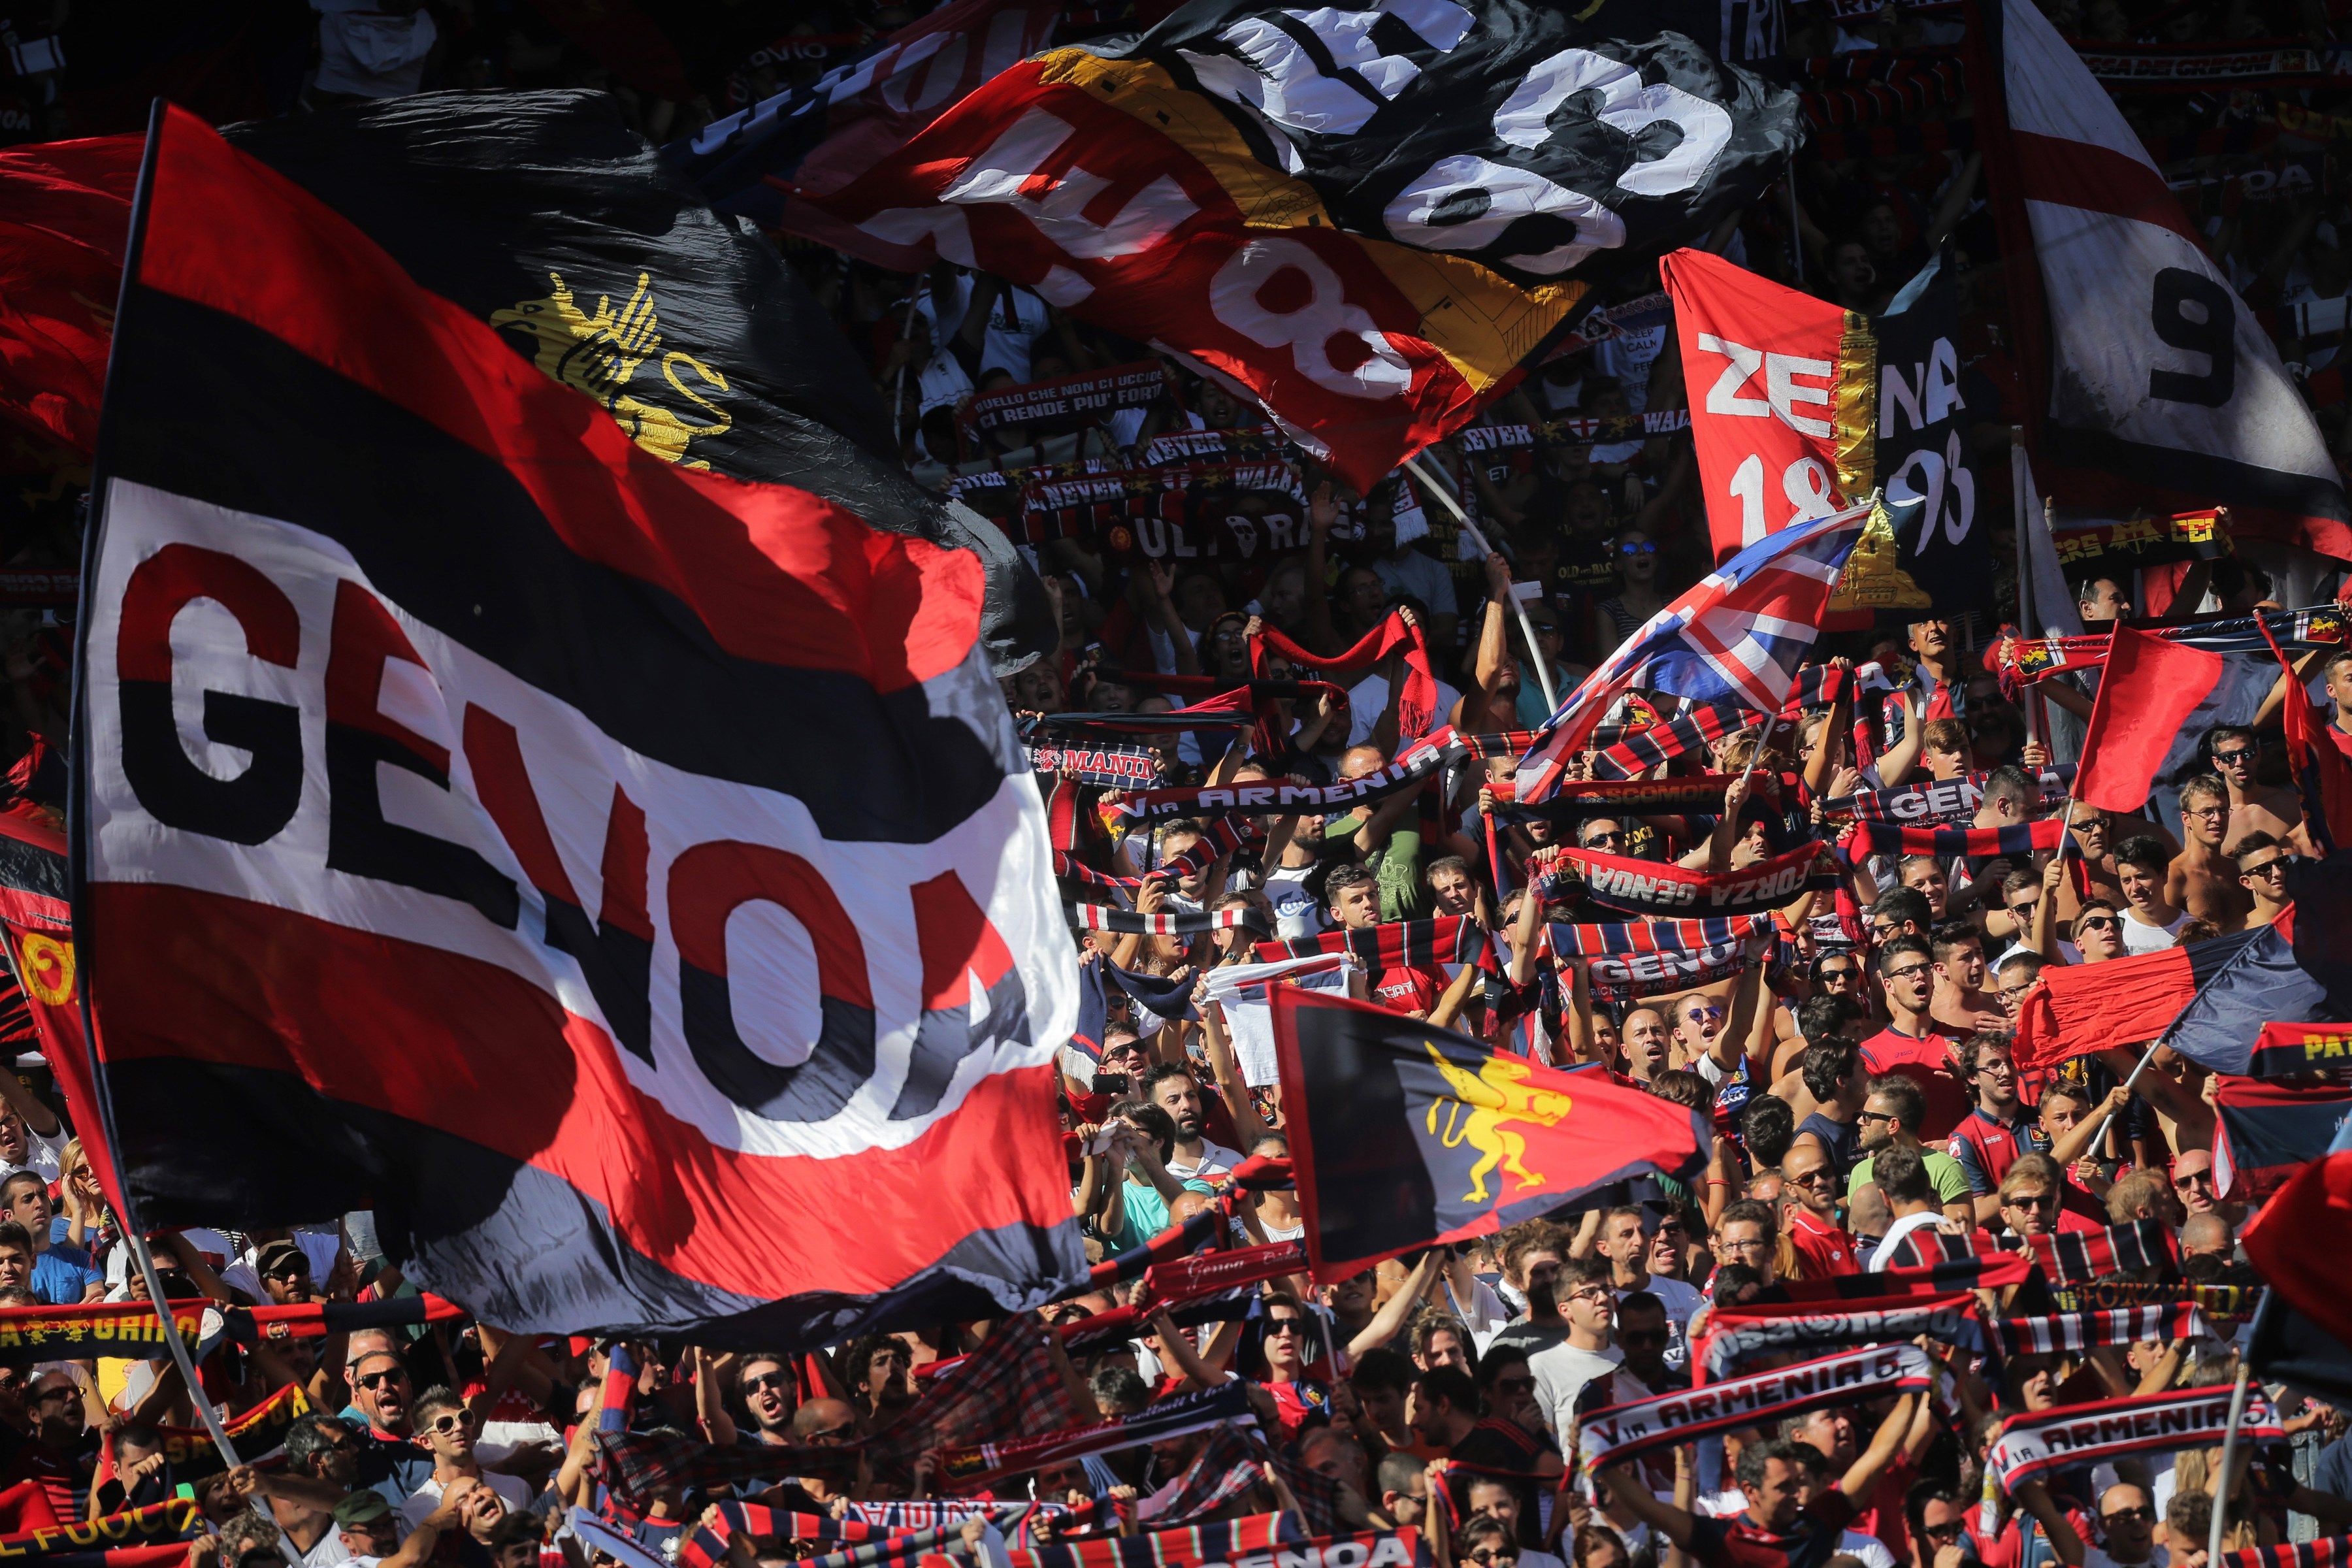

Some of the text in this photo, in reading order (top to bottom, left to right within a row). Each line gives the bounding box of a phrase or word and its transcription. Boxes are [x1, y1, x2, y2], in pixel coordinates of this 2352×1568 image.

[1028, 388, 1056, 402] CHE
[1060, 381, 1094, 397] NON
[1098, 378, 1113, 389] CI
[1117, 370, 1163, 387] UCCIDE
[1697, 331, 1965, 439] ZE NA
[979, 412, 998, 429] CI
[1002, 400, 1069, 423] RENDE
[1145, 433, 1226, 466] NEVER
[1040, 477, 1127, 508] NEVER
[1885, 429, 1976, 557] 93
[1198, 744, 1441, 808] ARMENIA
[1890, 772, 2067, 819] GENA
[118, 542, 1036, 1124] GENOA
[1590, 858, 1813, 906] FORZA GENOA
[1590, 961, 1745, 996] RICKET AND FOOTBAL
[1658, 1358, 1864, 1429] ARMENIA
[2042, 1400, 2229, 1454] ARMENIA
[32, 1498, 197, 1550] FUOCO
